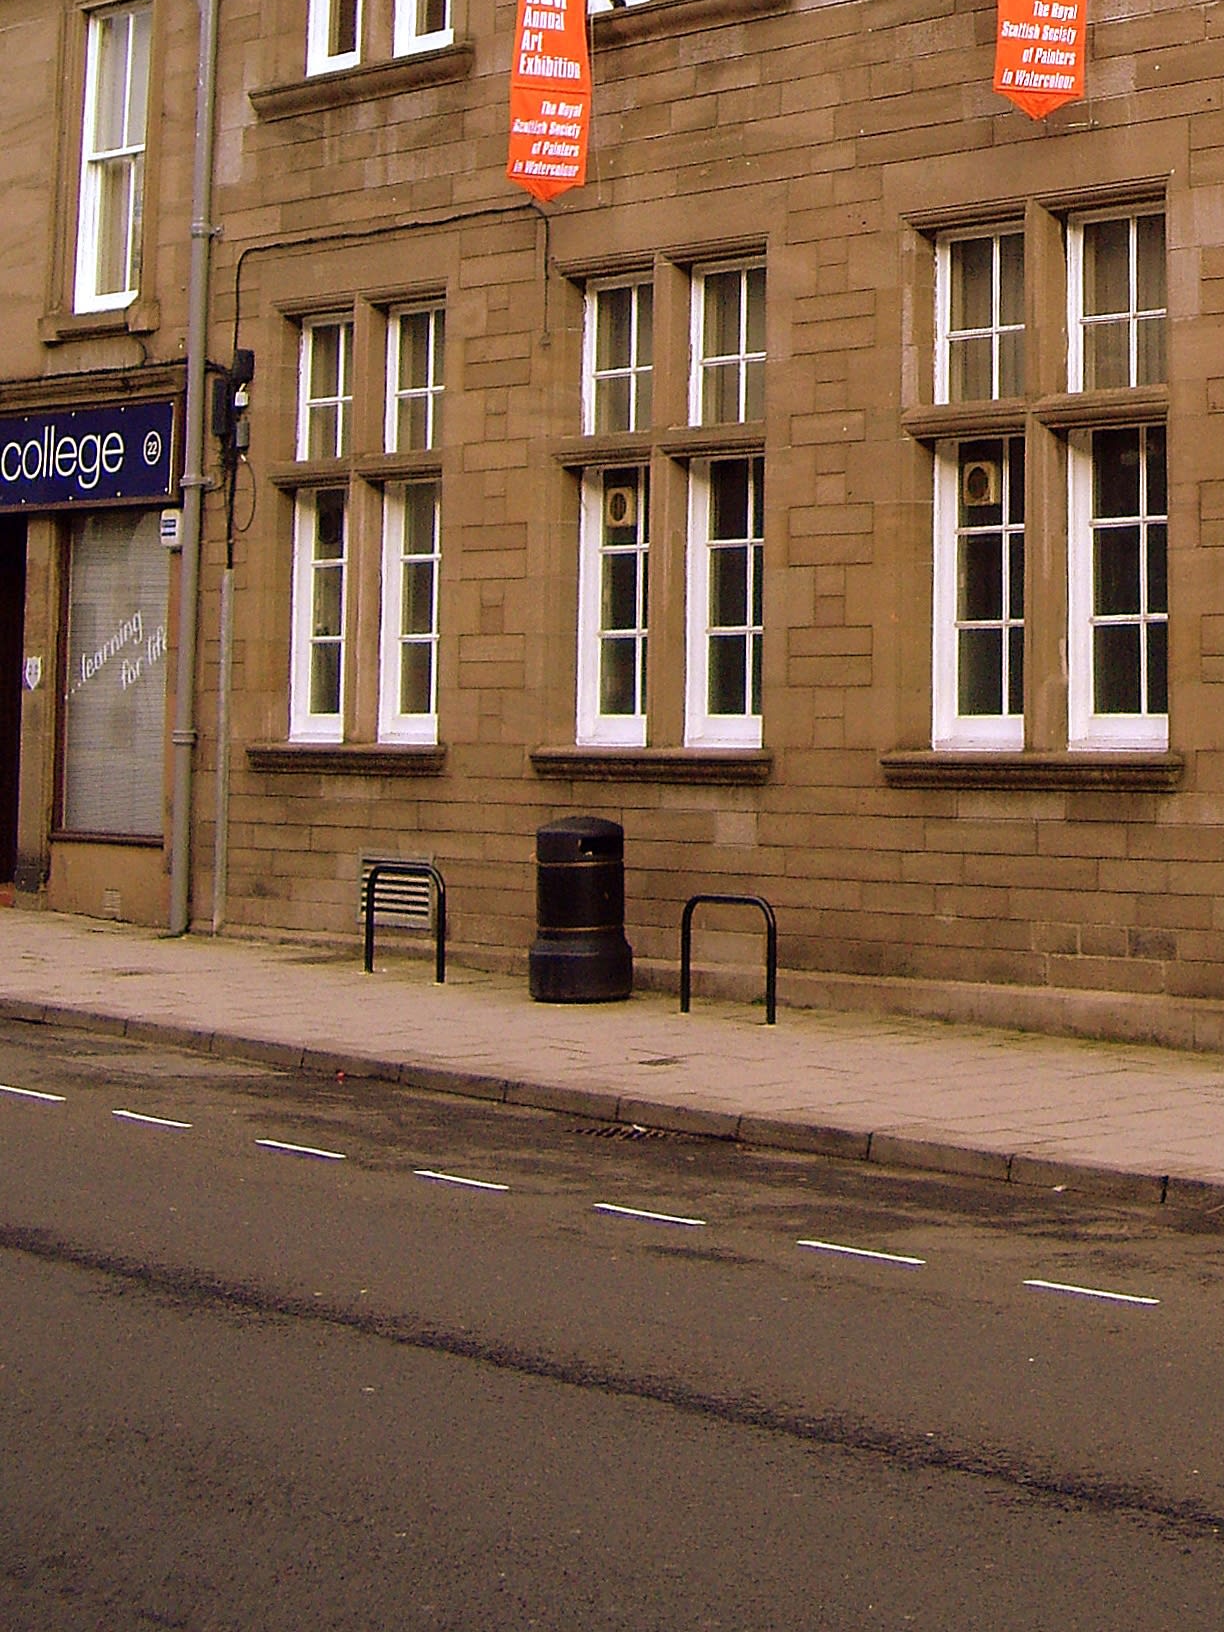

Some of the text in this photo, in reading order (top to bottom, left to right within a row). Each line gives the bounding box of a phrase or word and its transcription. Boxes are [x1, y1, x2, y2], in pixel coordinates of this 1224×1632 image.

[523, 5, 565, 31] Annual
[1033, 0, 1078, 21] The Royal
[521, 29, 543, 52] Art
[1001, 21, 1077, 45] Scottish Society
[519, 53, 581, 79] Exhibition
[1022, 47, 1076, 66] of Painters
[1001, 68, 1076, 89] in Watercolour
[541, 101, 557, 115] The
[1, 425, 158, 489] college 22
[121, 656, 144, 690] for
